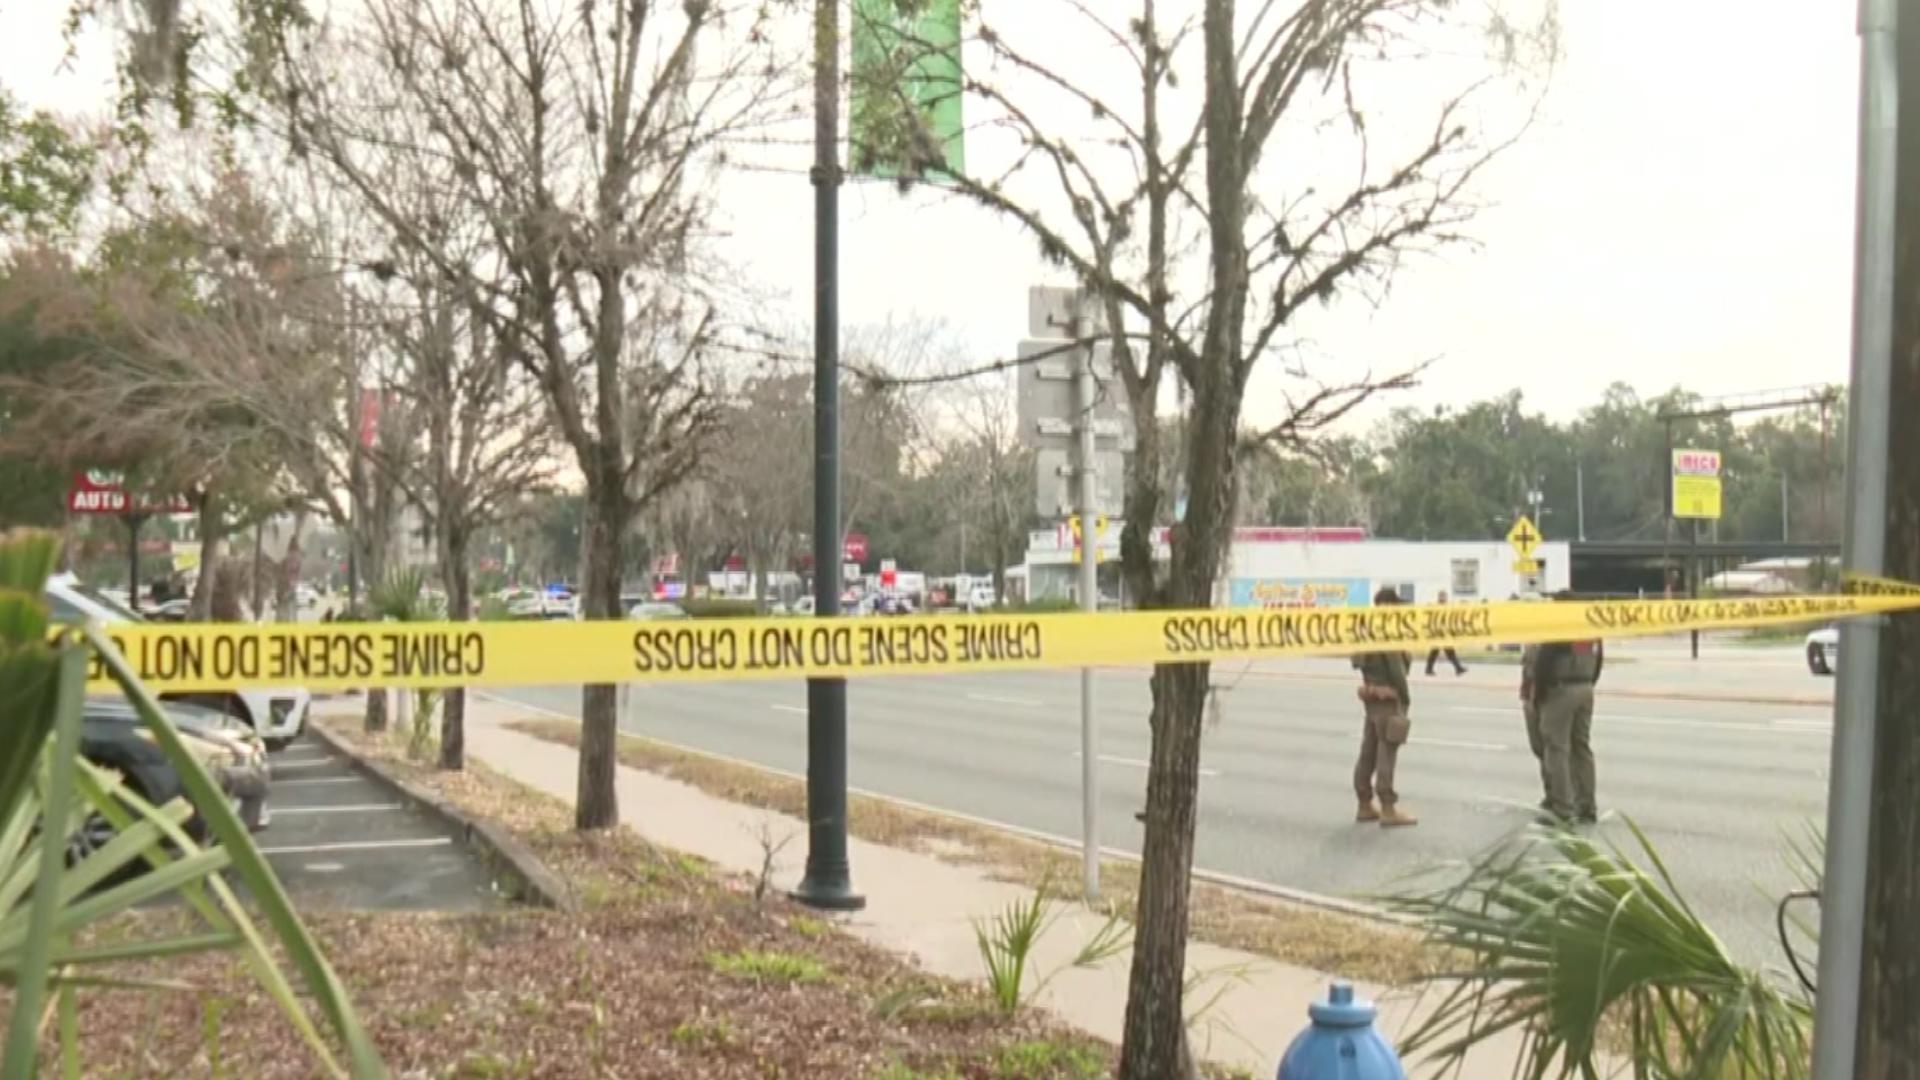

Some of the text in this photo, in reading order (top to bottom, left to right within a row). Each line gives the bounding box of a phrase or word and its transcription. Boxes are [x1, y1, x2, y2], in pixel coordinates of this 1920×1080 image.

[73, 491, 125, 509] AUTO
[633, 621, 1042, 672] CRIME SCENE DO NOT CROSS
[1163, 615, 1250, 653] CROSS
[1255, 614, 1304, 648] NOT
[1305, 612, 1343, 646] DO
[1345, 609, 1419, 643] SCENE
[138, 635, 204, 681] NOT
[213, 635, 260, 681] DO
[268, 633, 374, 680] SCENE
[381, 631, 485, 677] CRIME
